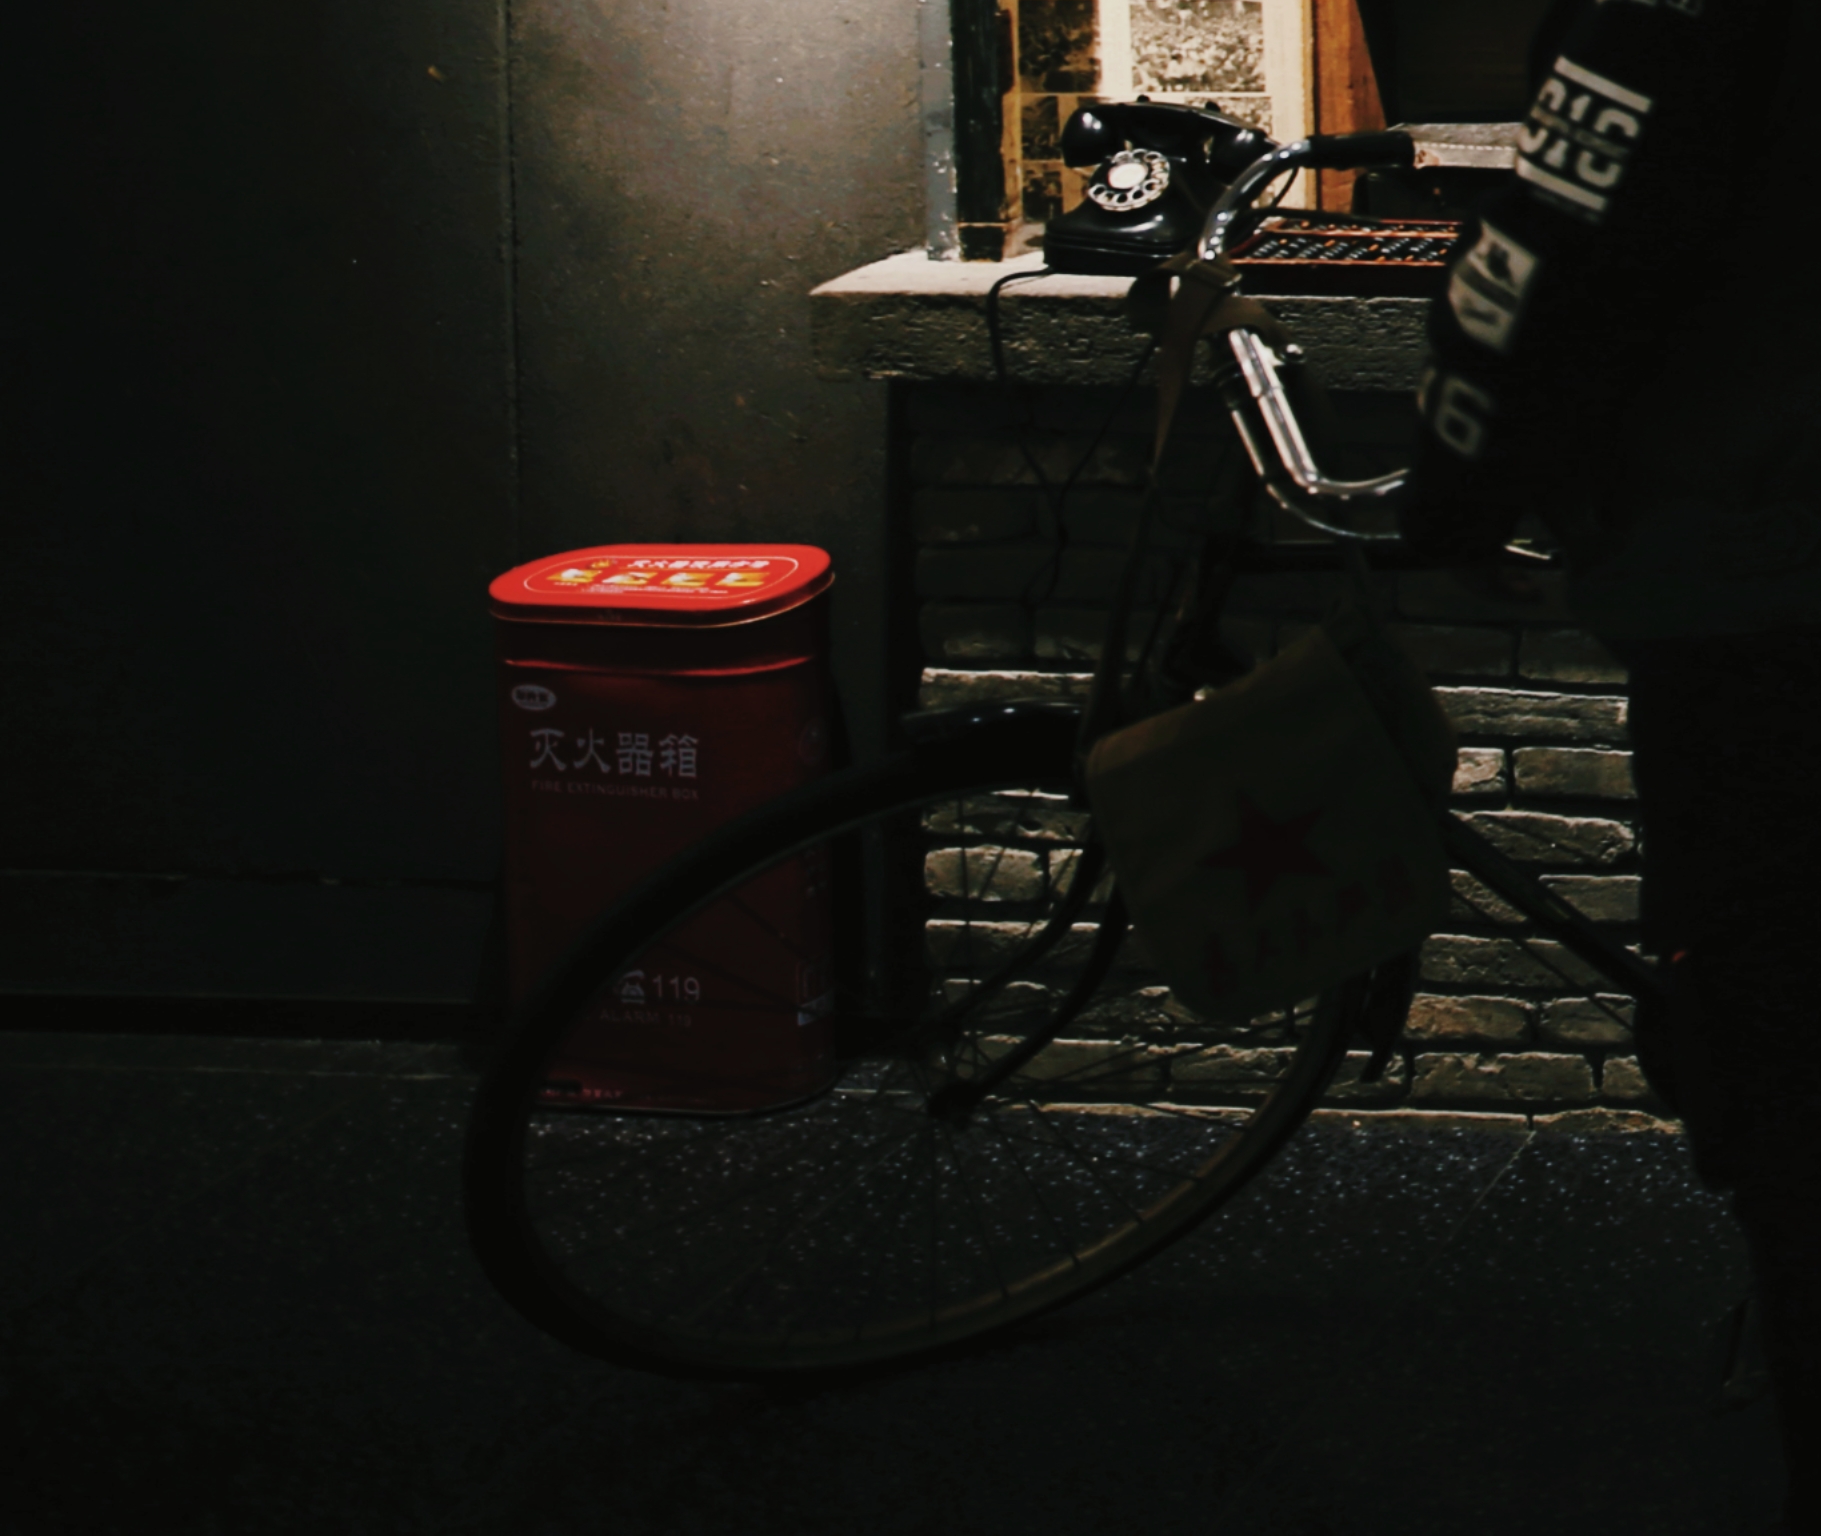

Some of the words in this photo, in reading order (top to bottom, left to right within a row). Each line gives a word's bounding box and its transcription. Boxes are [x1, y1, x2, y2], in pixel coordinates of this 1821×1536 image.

[529, 726, 699, 779] 灭火器箱
[531, 780, 562, 793] FIRE
[568, 781, 668, 799] EXTINGUISHER
[671, 787, 700, 801] BOX
[652, 974, 702, 1002] 119
[599, 1008, 660, 1025] ALARM
